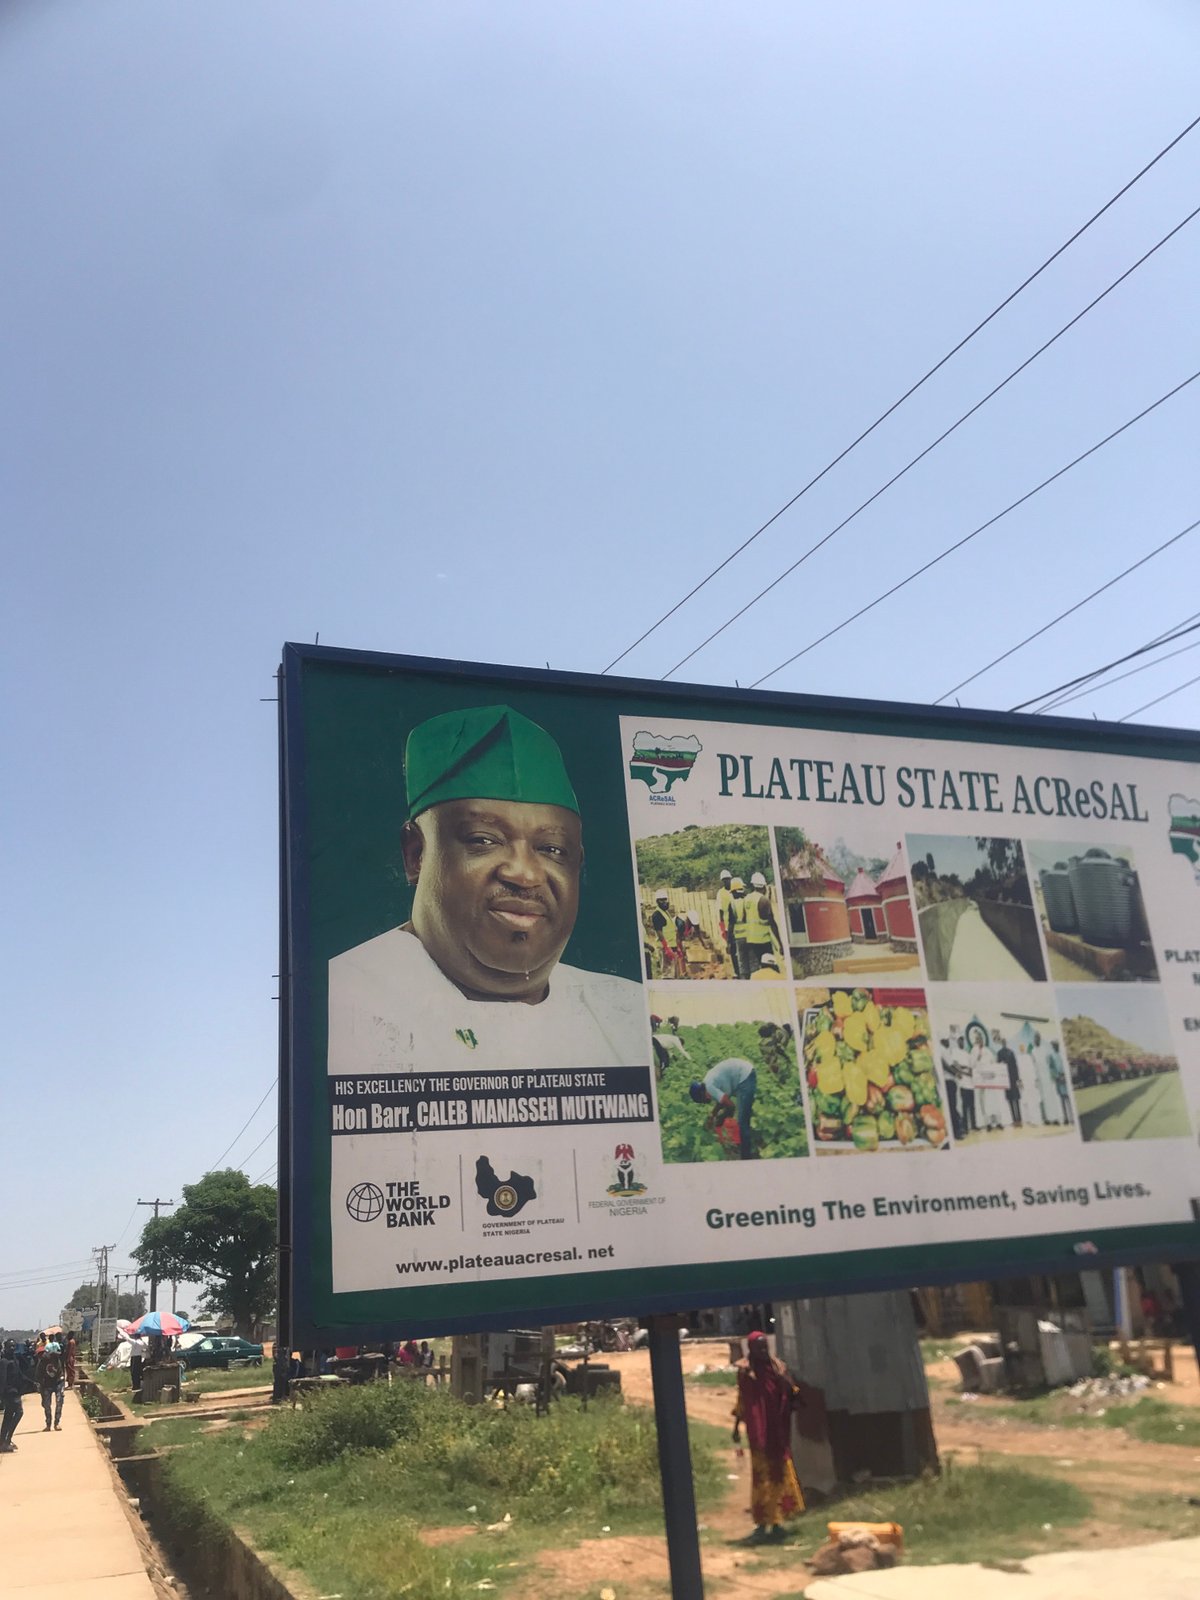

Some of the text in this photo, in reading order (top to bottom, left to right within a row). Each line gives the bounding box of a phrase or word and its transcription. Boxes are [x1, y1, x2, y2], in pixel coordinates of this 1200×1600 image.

[716, 753, 1149, 823] PLATEAU STATE ACReSAL
[335, 1073, 605, 1095] HIS EXCELLENCY THE GOVERNOR OF PLATEAU STATE
[332, 1094, 648, 1130] Hon Barr. CALEB MANASSEH MUTFWANG
[386, 1181, 420, 1197] THE
[386, 1195, 450, 1211] WORLD
[589, 1200, 615, 1208] FEDERAL
[617, 1198, 656, 1207] GOVERNMENT
[706, 1180, 1151, 1230] Greening The Environment, Saving Lives.
[386, 1211, 435, 1228] BANK
[609, 1207, 648, 1216] NIGERIA
[588, 1245, 614, 1259] net
